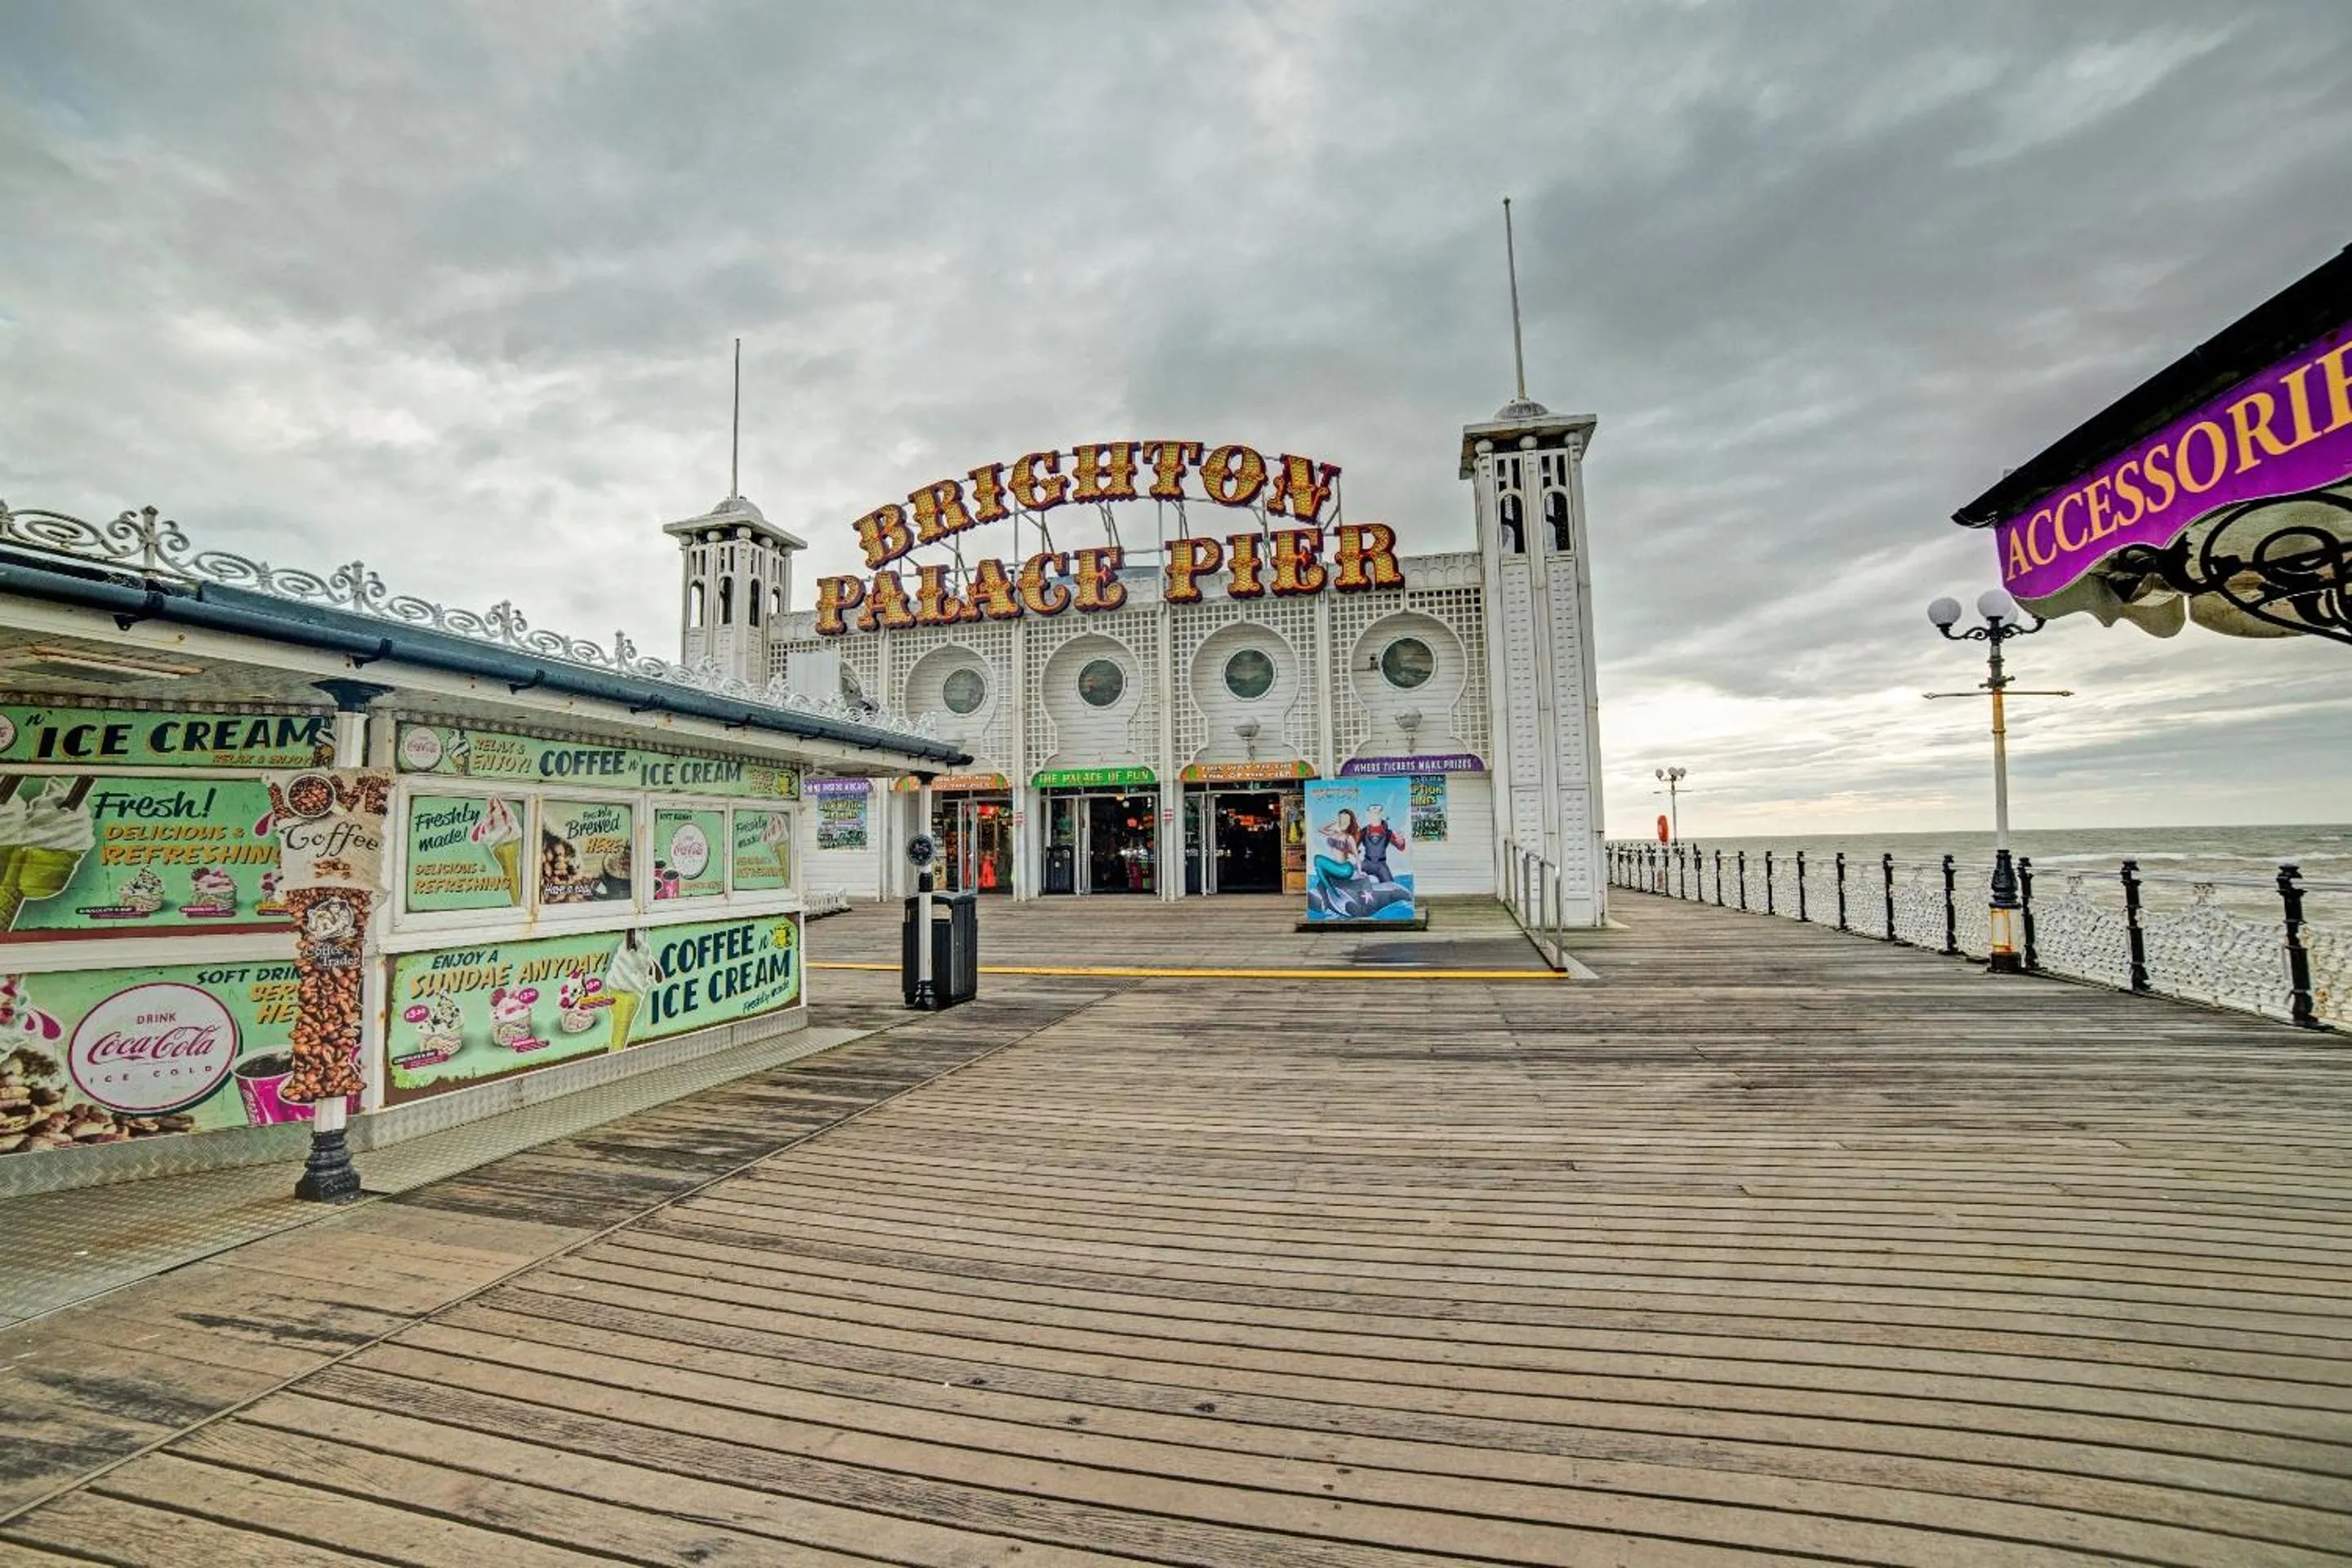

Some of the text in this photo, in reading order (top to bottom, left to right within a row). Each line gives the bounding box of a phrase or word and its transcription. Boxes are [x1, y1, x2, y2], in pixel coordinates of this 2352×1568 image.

[2005, 341, 2352, 581] ACCESSORIE
[853, 441, 1342, 570] BRIGHTON
[816, 523, 1405, 635] PALACE PIER
[37, 723, 134, 759] ICE
[150, 717, 323, 753] CREAM
[474, 737, 514, 754] RELAX
[471, 753, 532, 773] ENJOY!
[539, 750, 626, 777] COFFEE
[641, 763, 675, 786] ICE
[680, 761, 742, 785] CREAM
[1039, 774, 1058, 784] THE
[1062, 773, 1102, 785] PALACE
[1127, 769, 1149, 781] FUN
[93, 787, 217, 820] Fresh!
[415, 802, 480, 832] Freshly
[565, 814, 621, 840] Brewed
[105, 826, 229, 841] DELICIOUS
[278, 820, 380, 858] Coffee
[418, 826, 468, 852] made!
[413, 863, 478, 875] DELICIOUS
[412, 877, 512, 895] REFRESHING
[319, 955, 362, 968] Trader
[431, 949, 498, 970] ENJOY A
[660, 924, 755, 978] COFFEE
[196, 966, 302, 985] SOFT DRIN
[410, 952, 610, 1000] SUNDAE ANYDAY!
[651, 949, 791, 1025] ICE CREAM
[251, 982, 297, 1003] SER
[137, 1013, 177, 1025] DRINK
[256, 1002, 296, 1025] HE
[87, 1025, 220, 1066] Coca-Cola
[89, 1065, 213, 1085] ICE COLD
